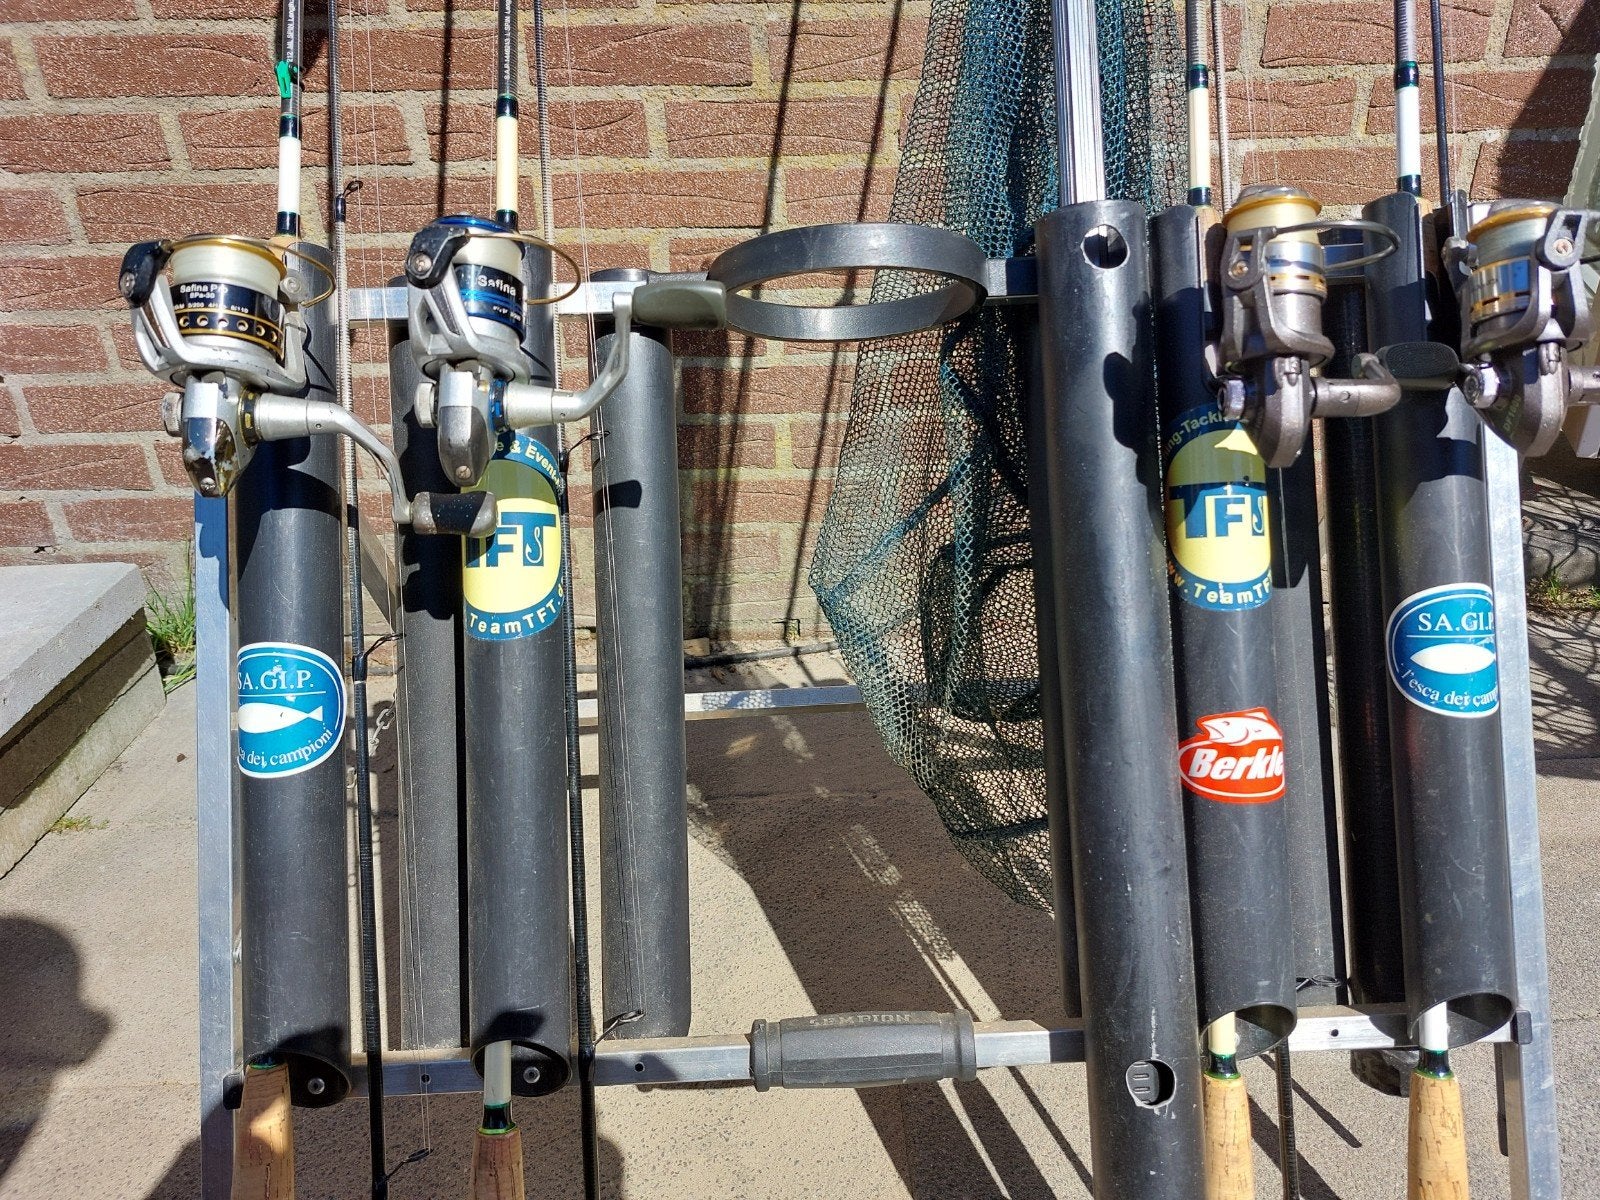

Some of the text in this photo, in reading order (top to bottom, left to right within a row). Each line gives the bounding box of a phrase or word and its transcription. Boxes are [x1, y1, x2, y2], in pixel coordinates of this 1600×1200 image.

[180, 283, 209, 294] Safina
[477, 274, 517, 296] Safina
[269, 727, 333, 766] campioni
